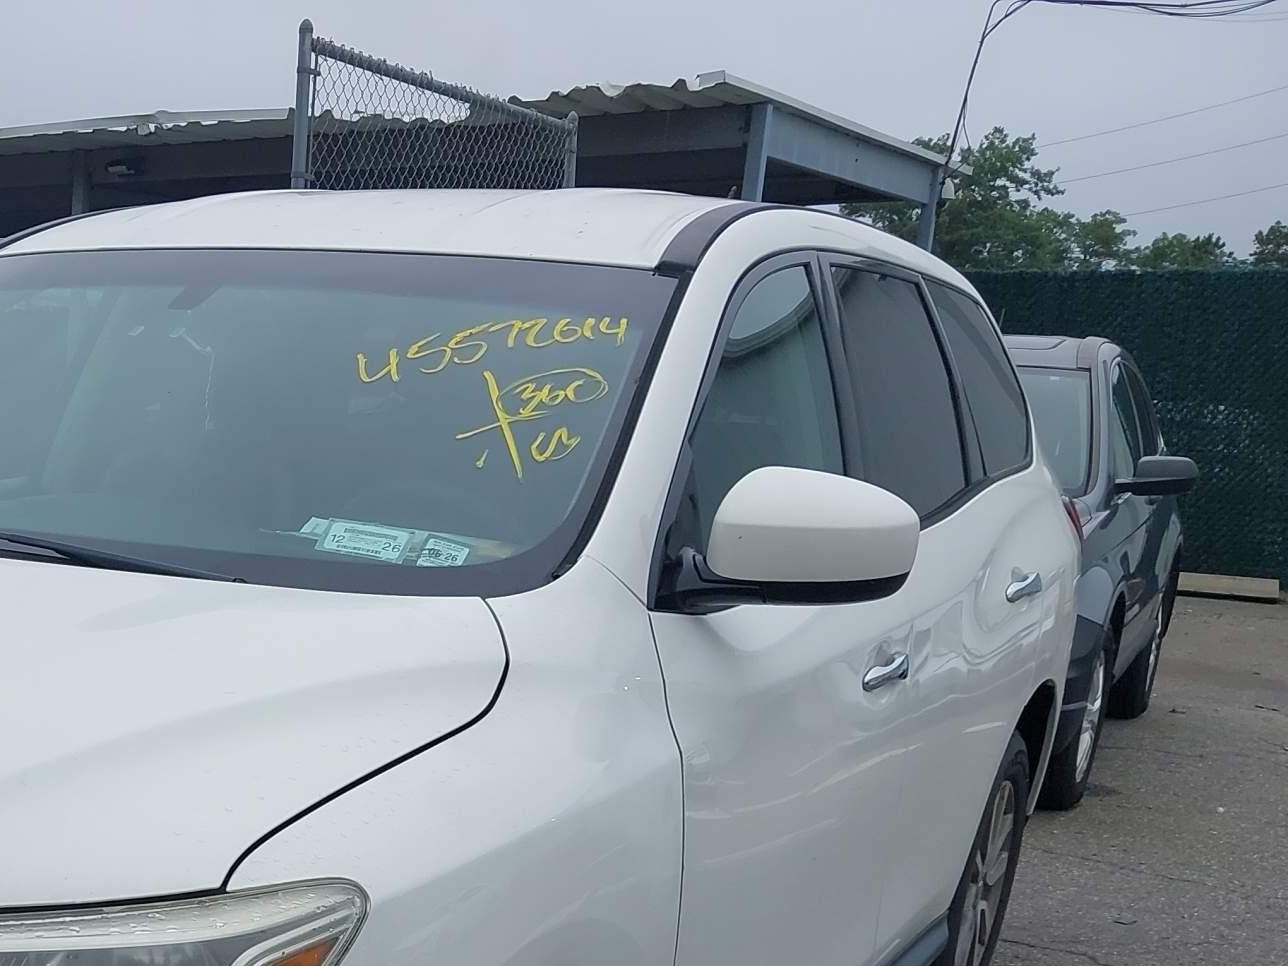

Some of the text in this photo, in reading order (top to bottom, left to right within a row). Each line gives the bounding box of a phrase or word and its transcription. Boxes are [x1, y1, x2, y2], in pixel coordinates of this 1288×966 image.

[330, 533, 346, 544] 12
[382, 541, 402, 553] 26
[444, 552, 460, 562] 26
